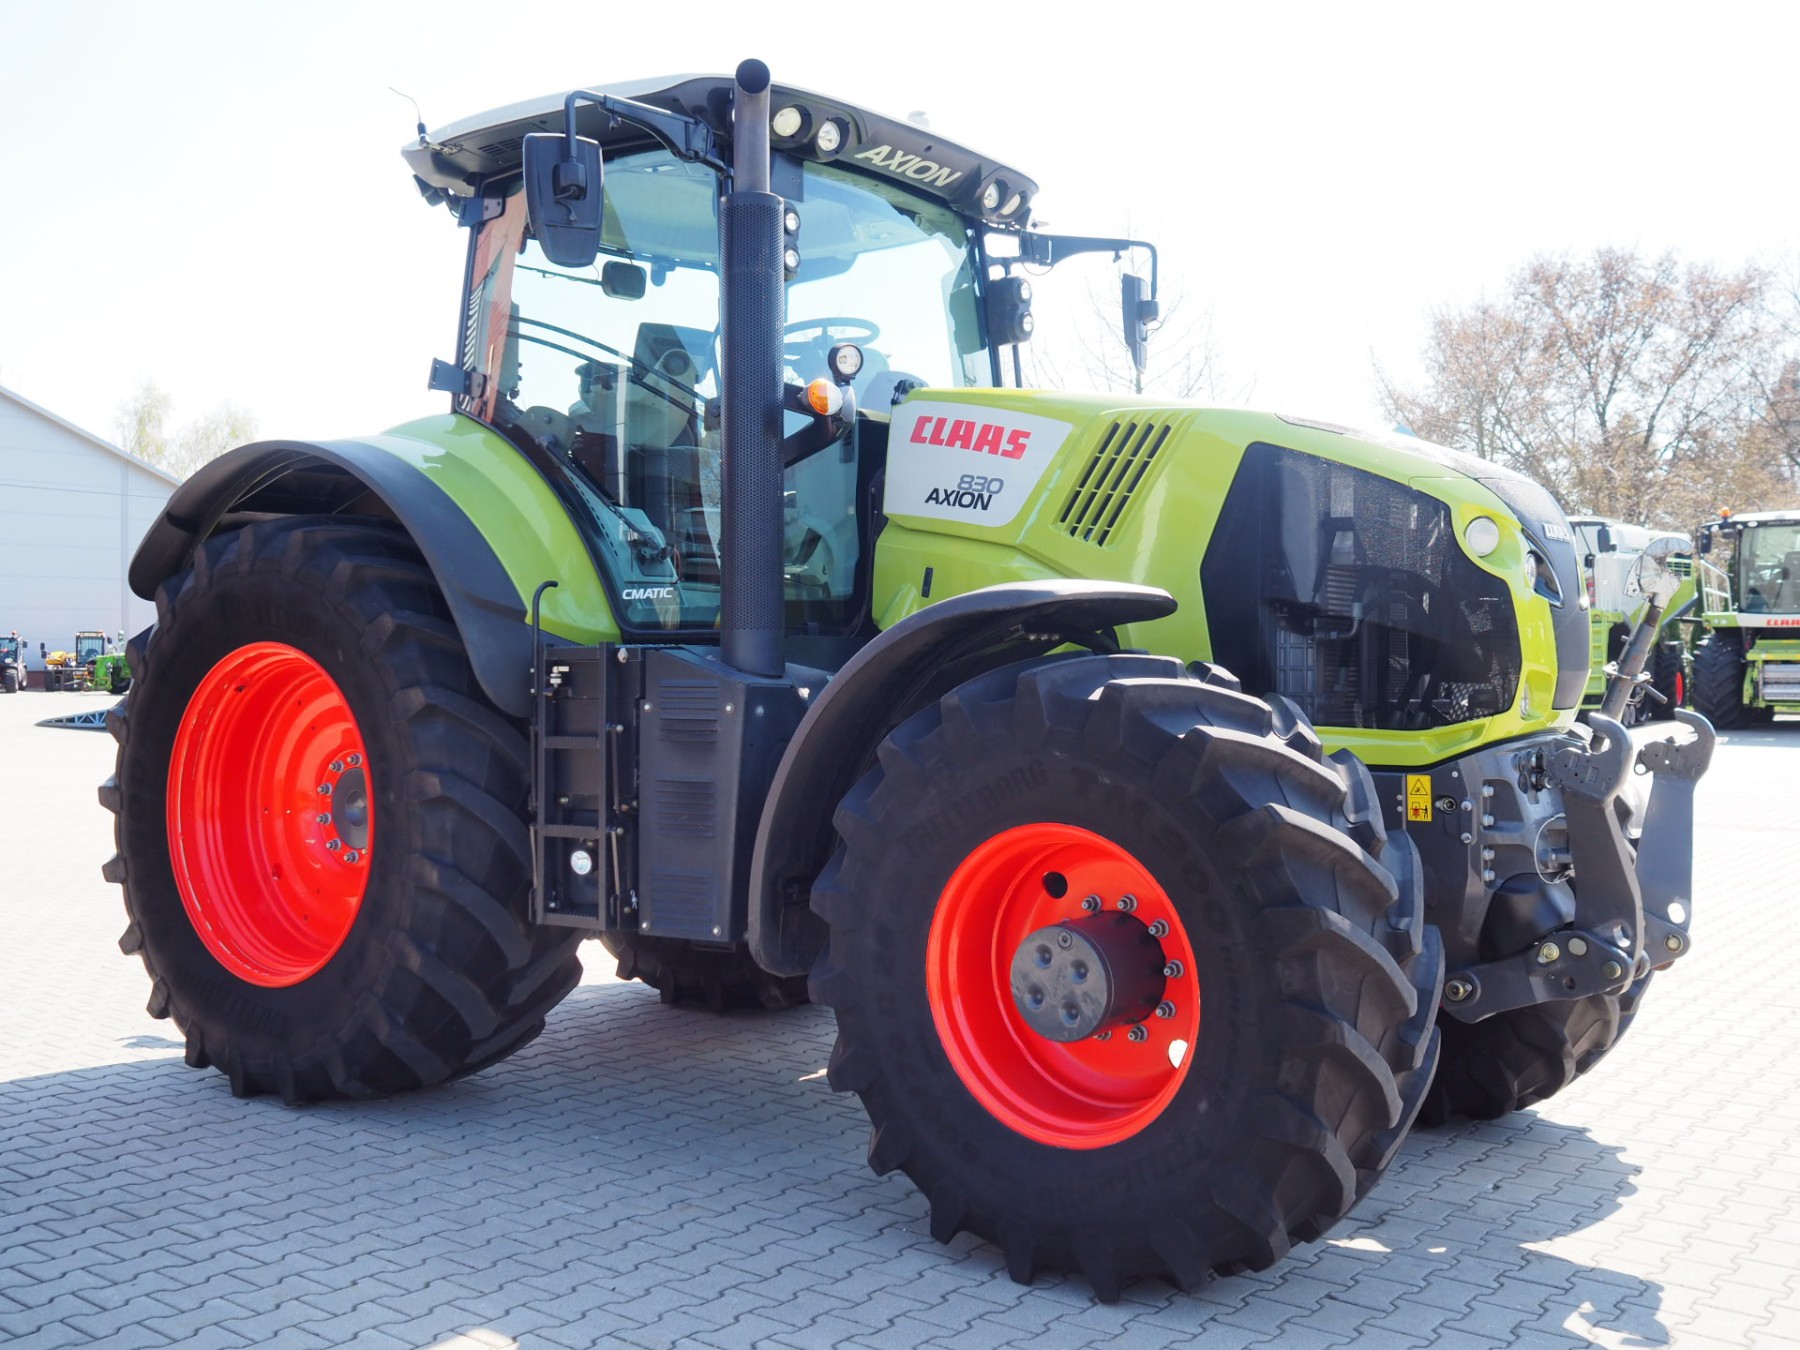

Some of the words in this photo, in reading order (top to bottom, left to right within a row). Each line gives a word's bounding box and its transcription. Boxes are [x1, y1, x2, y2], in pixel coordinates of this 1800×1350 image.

[854, 145, 962, 187] AXION
[910, 415, 1032, 460] CLAAS
[957, 474, 1005, 495] 830
[924, 488, 993, 511] AXION
[622, 587, 674, 600] CMATIC
[1766, 618, 1800, 627] CLAA
